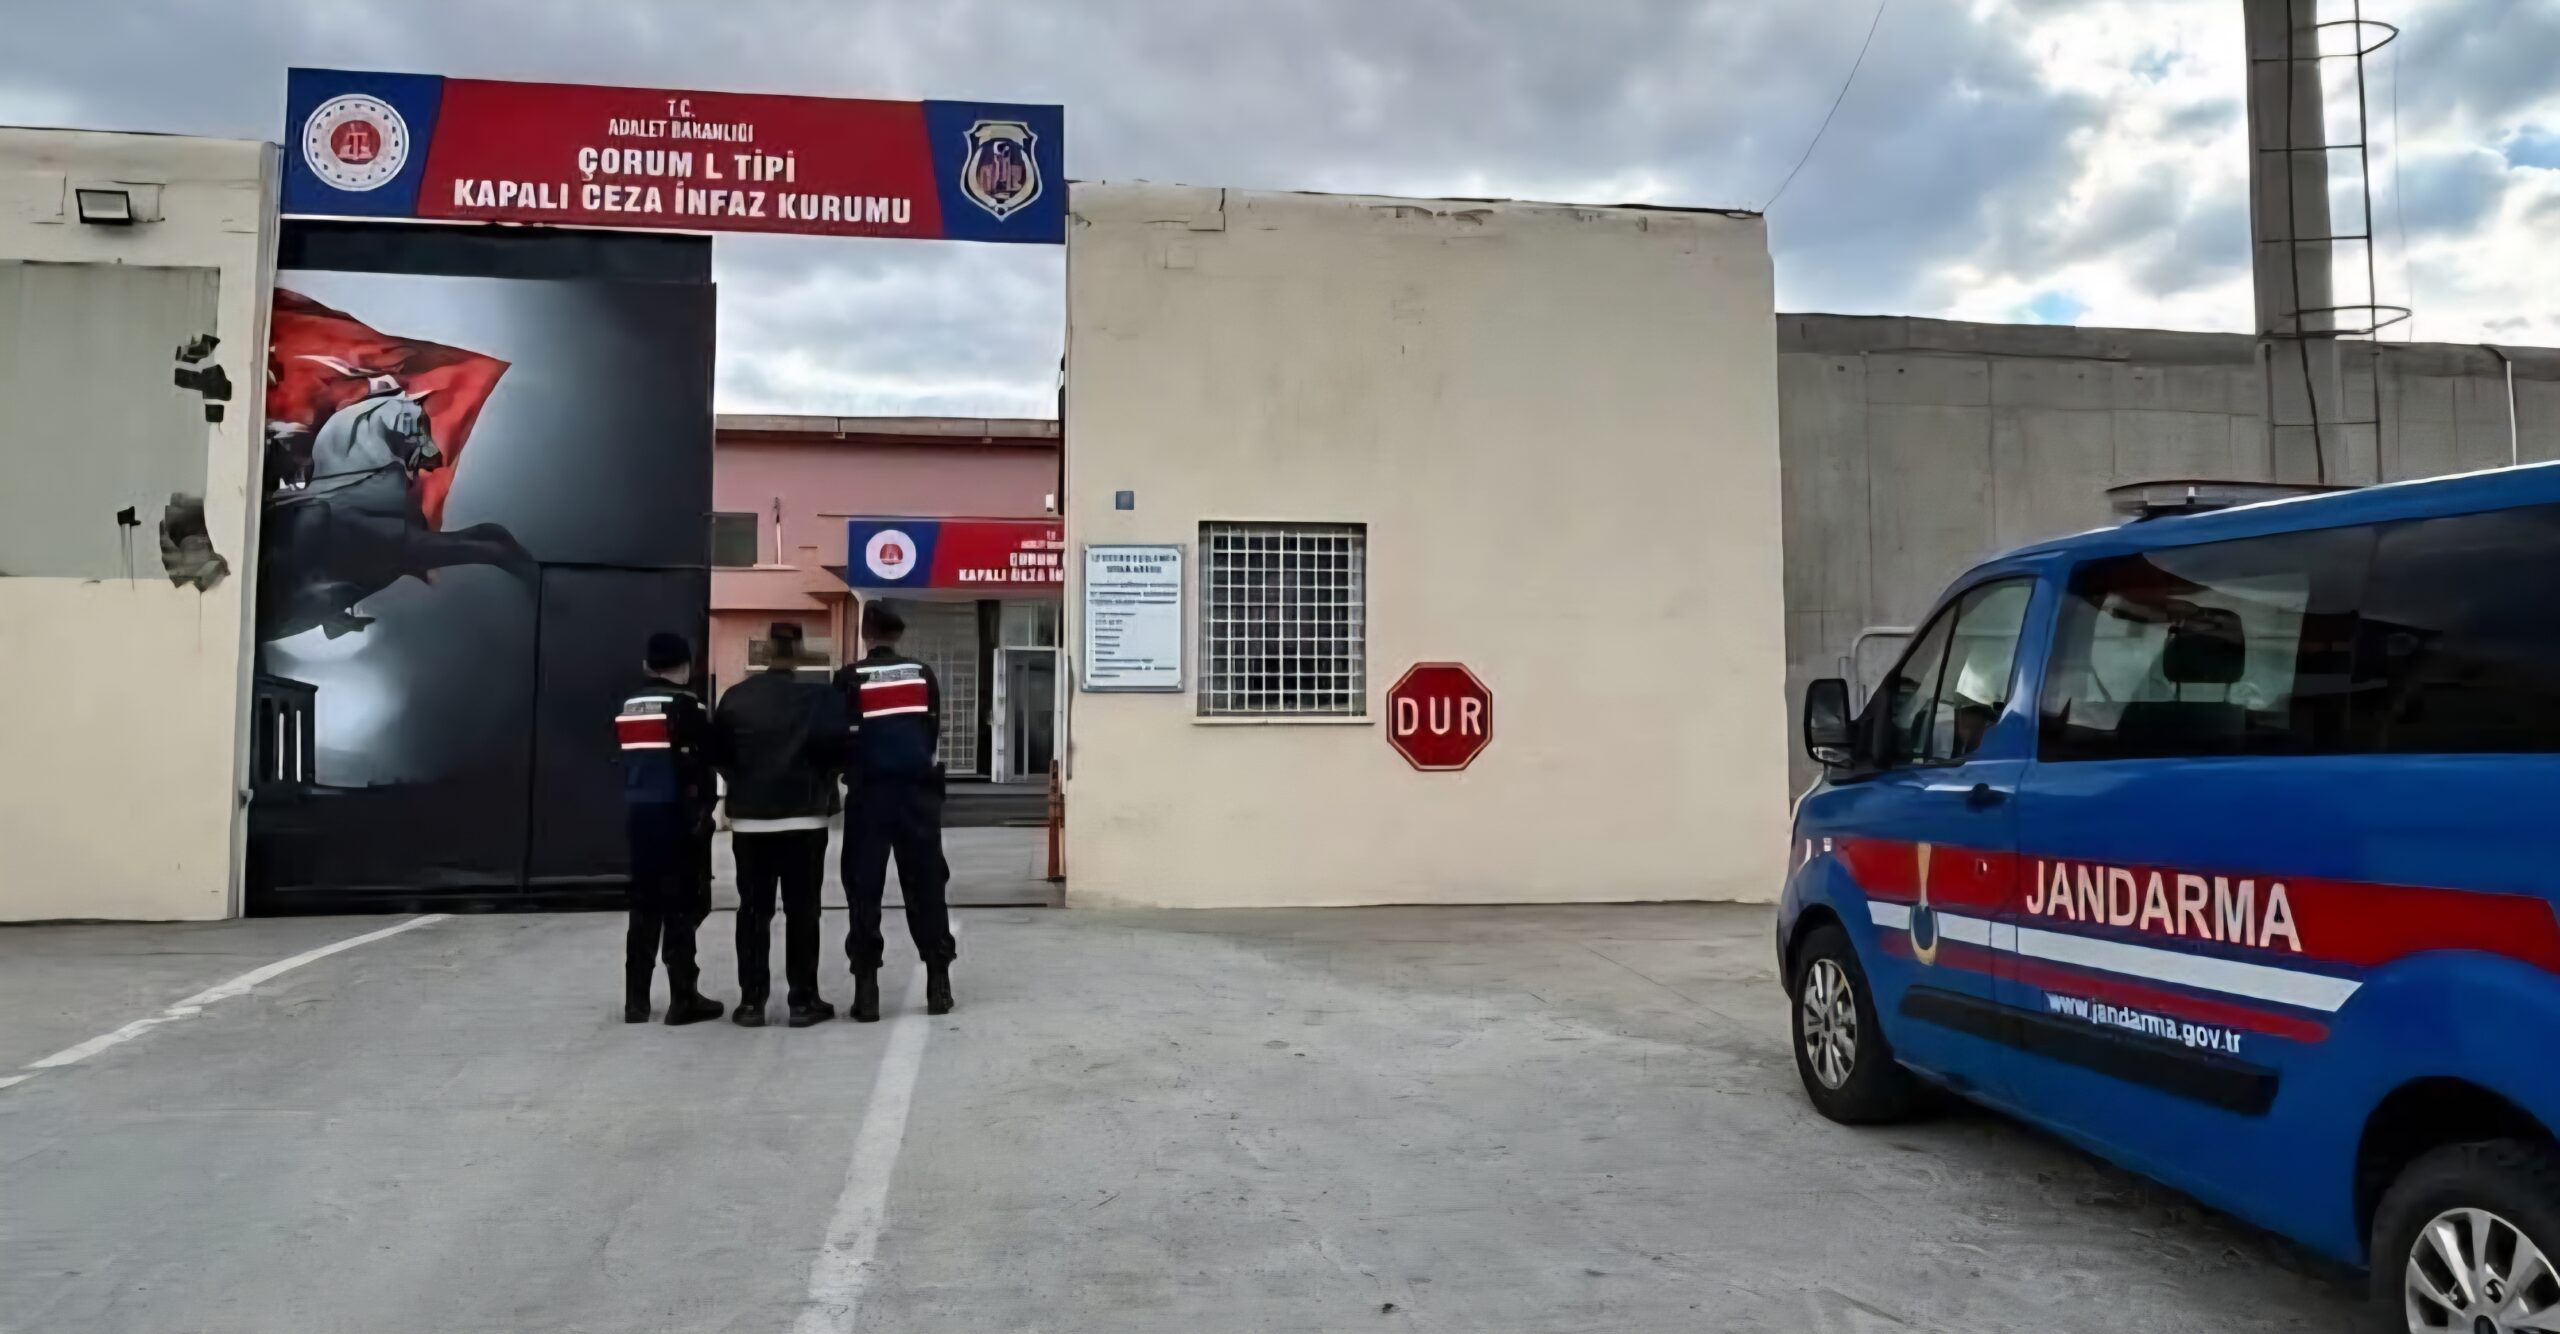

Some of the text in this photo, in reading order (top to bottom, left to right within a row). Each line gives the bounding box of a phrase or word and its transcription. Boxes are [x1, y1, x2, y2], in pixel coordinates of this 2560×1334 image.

[608, 118, 667, 138] ADALET
[578, 147, 796, 183] ÇORUM L TİPİ
[453, 178, 911, 224] KAPALI CEZA İNFAZ KURUMU
[1397, 696, 1482, 736] DUR
[2026, 860, 2303, 952] JANDARMA
[2044, 992, 2241, 1053] www.jandarma.gov.tr
